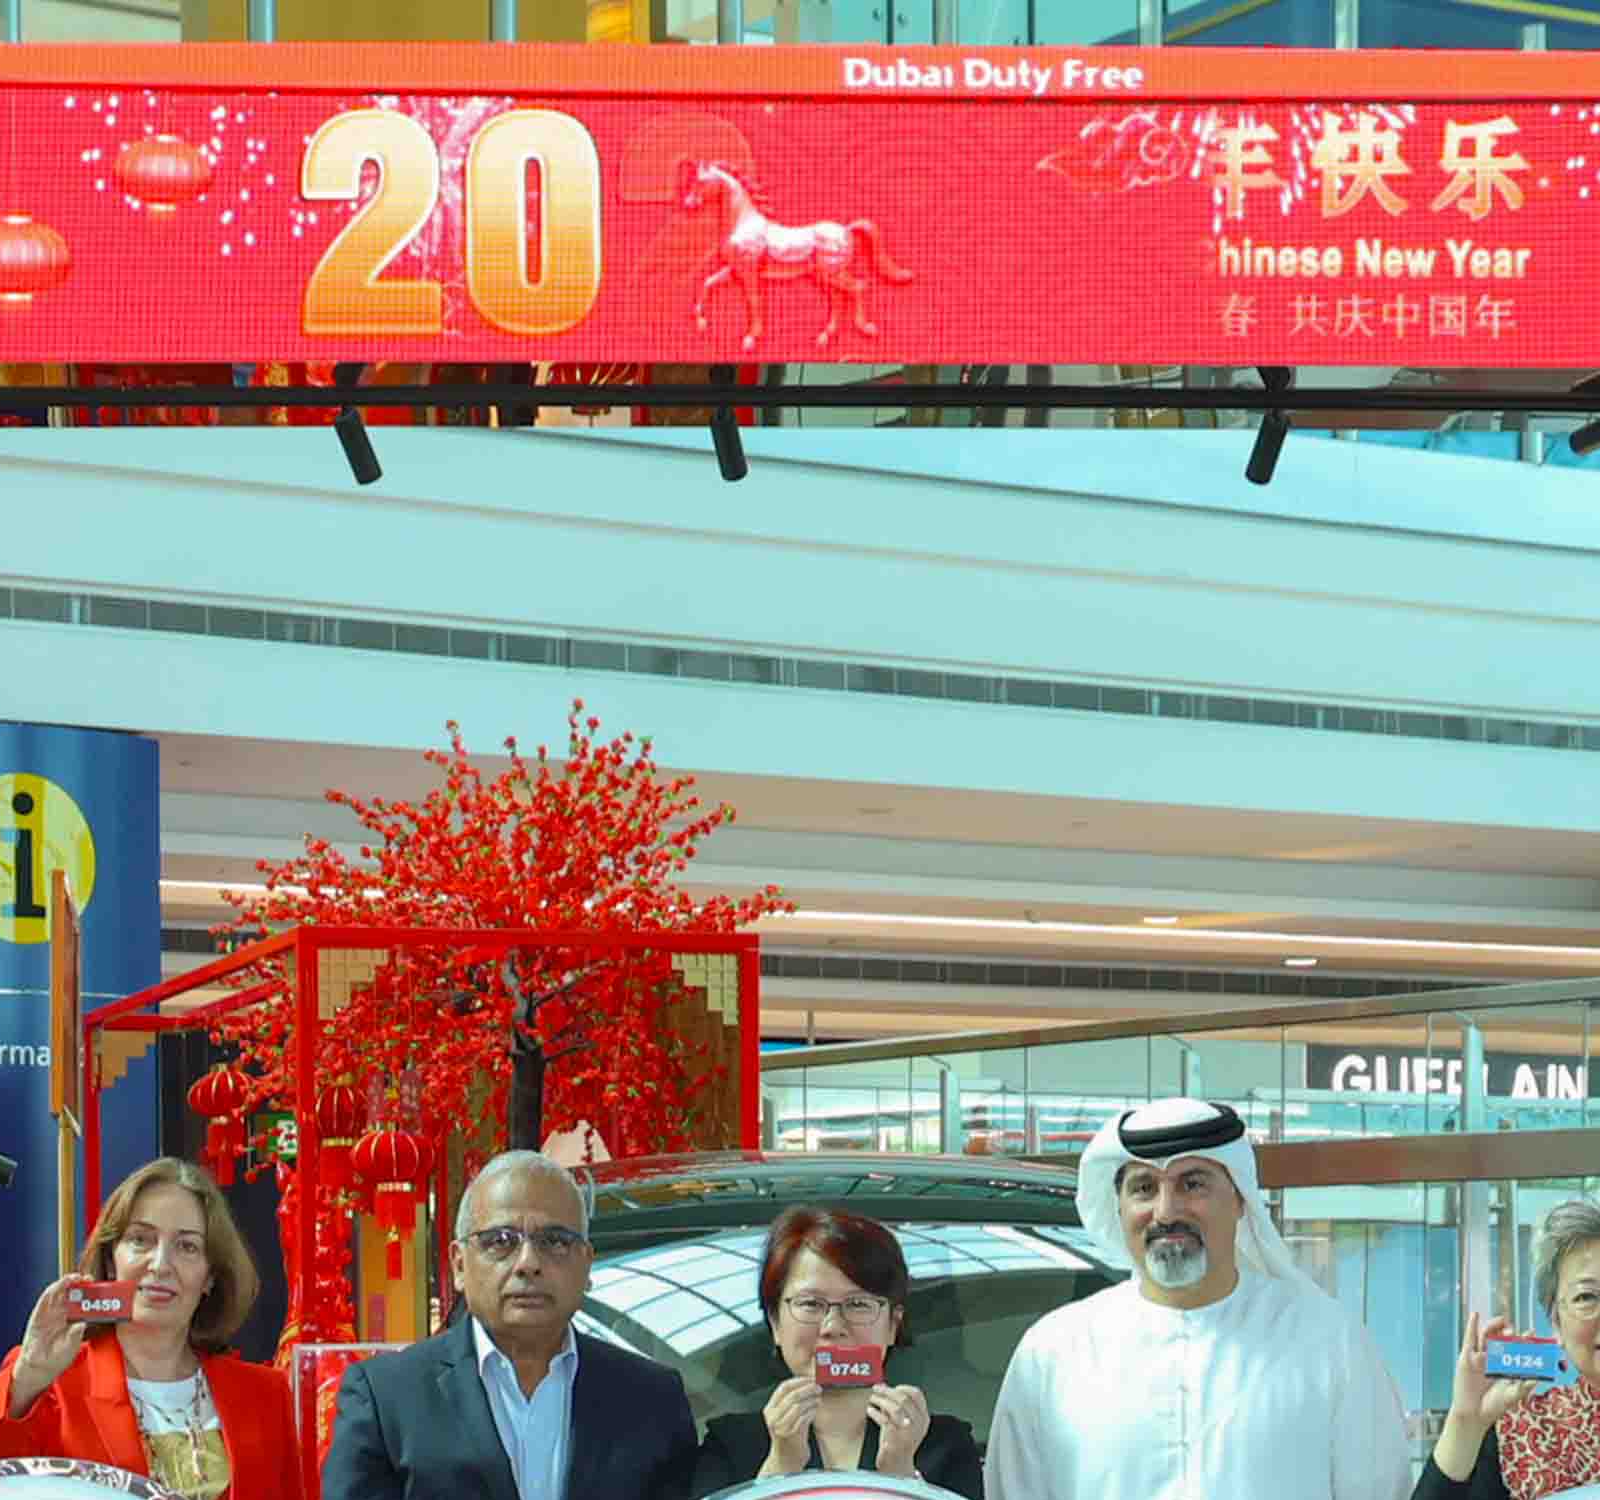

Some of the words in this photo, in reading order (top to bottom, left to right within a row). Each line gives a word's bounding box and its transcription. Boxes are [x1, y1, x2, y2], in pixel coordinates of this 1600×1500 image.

[843, 57, 953, 88] Dubai
[963, 58, 1054, 96] Duty
[1063, 58, 1145, 90] Free
[301, 107, 602, 335] 20
[1217, 236, 1344, 279] hinese
[1354, 237, 1439, 279] New
[1444, 237, 1533, 279] Year
[81, 1299, 121, 1312] 0459
[830, 1363, 871, 1377] 0742
[1502, 1353, 1544, 1369] 0124
